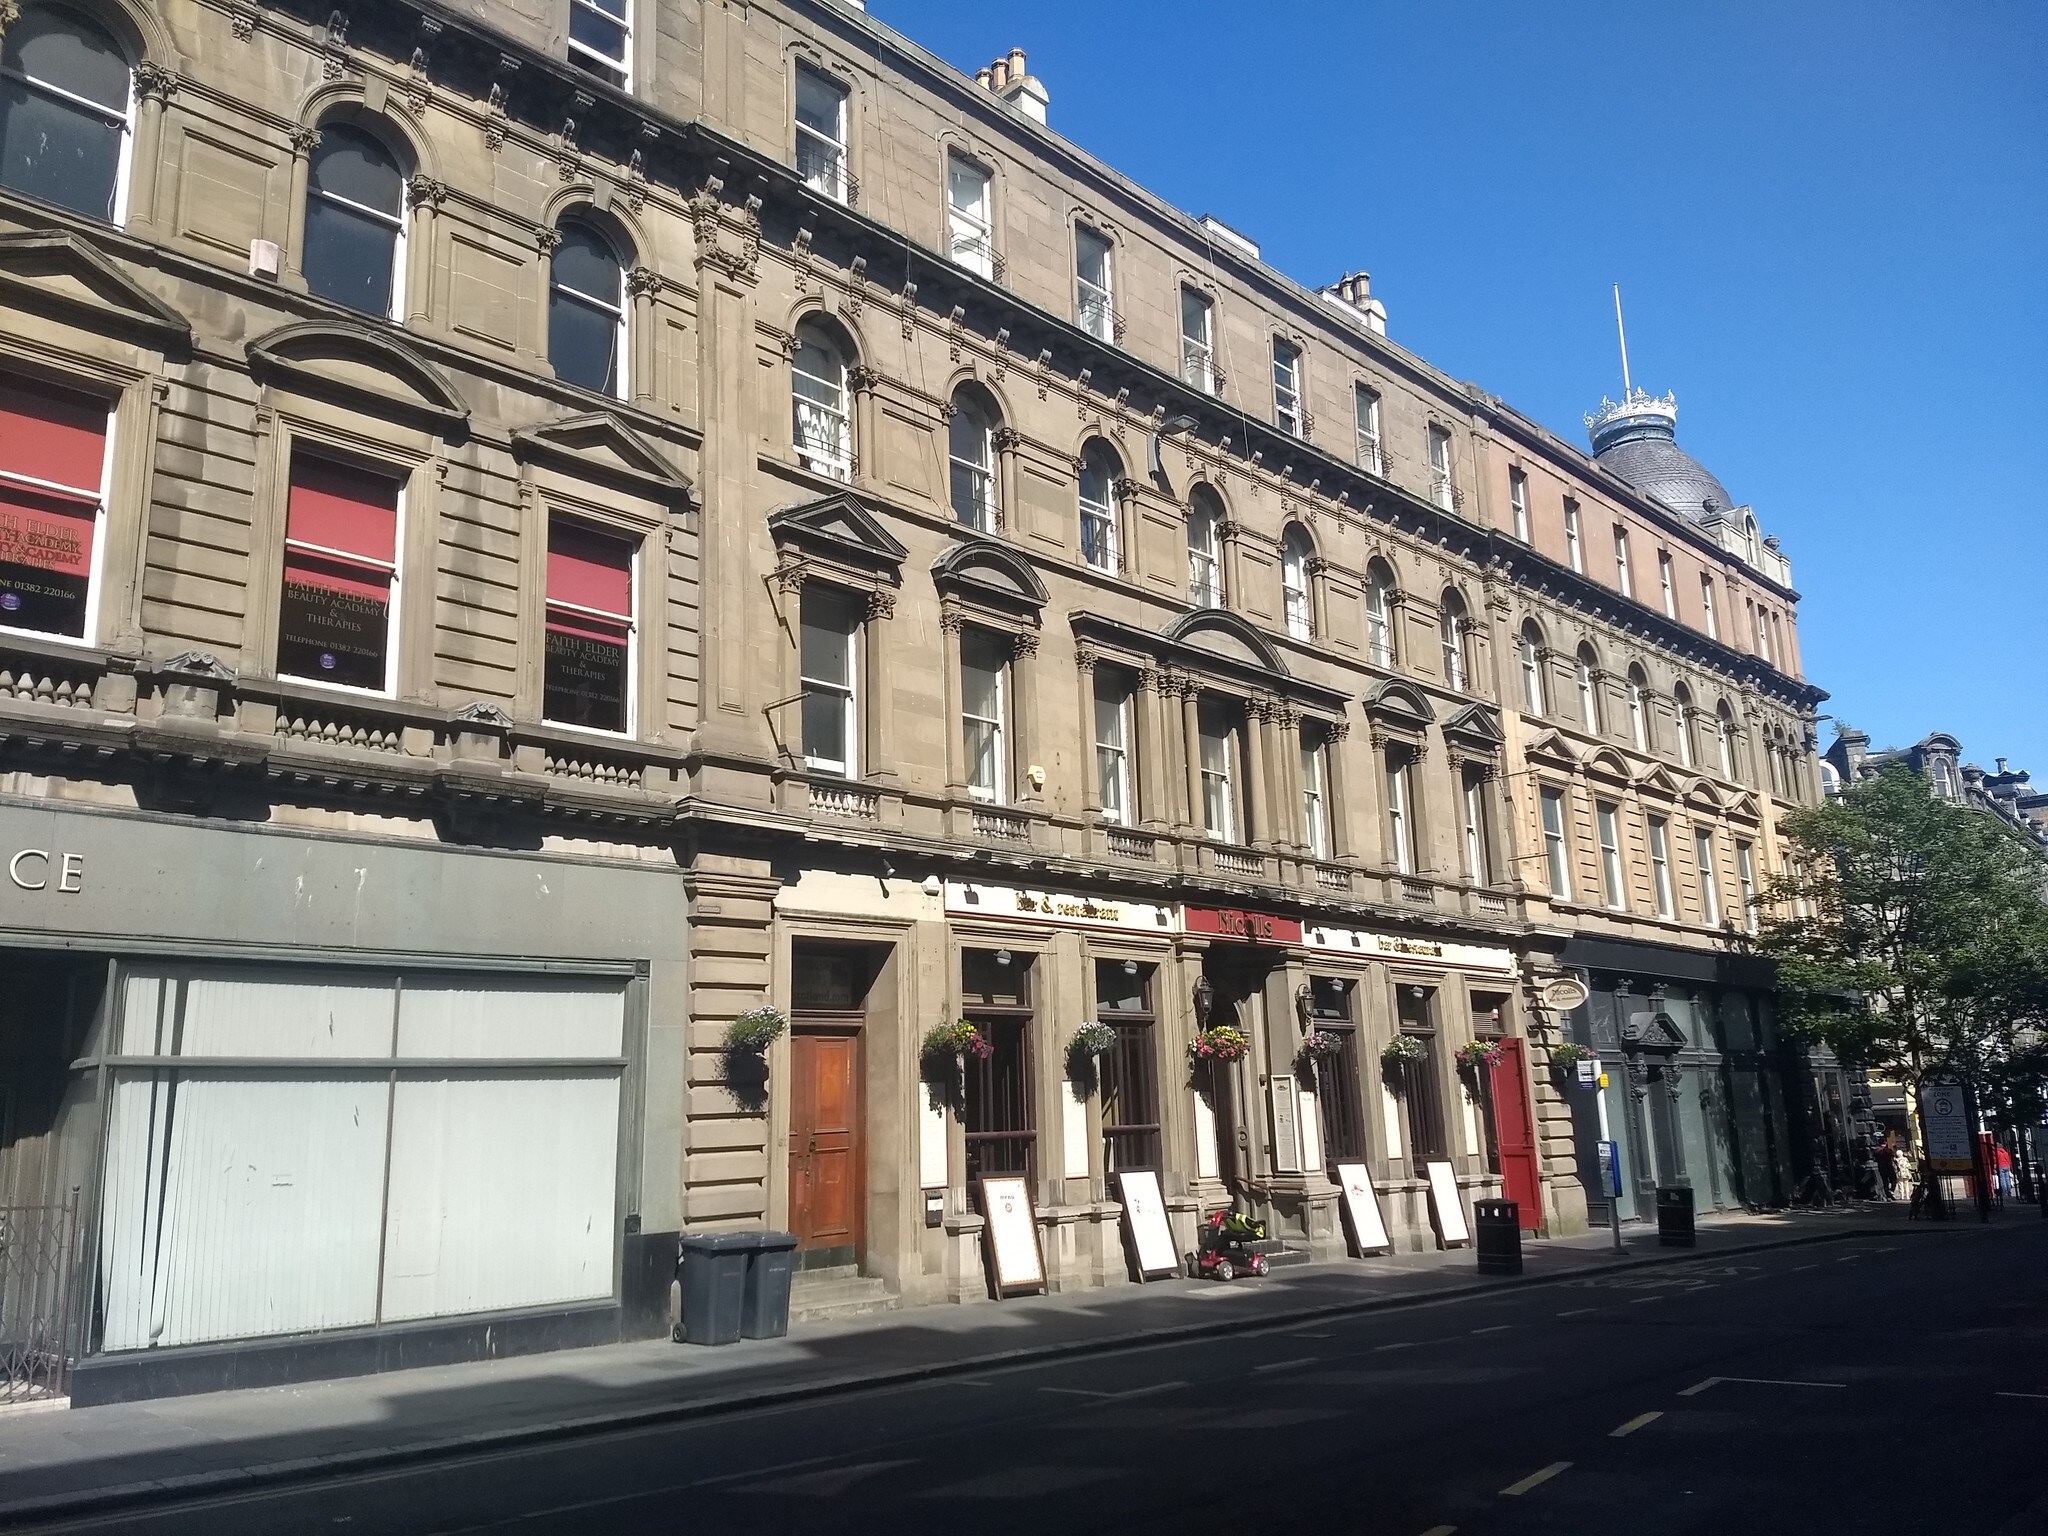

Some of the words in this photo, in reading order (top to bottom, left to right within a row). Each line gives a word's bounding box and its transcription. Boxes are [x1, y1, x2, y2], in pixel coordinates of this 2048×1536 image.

[27, 519, 79, 542] ELDER
[16, 543, 26, 554] &
[18, 532, 81, 553] ACADEMY
[14, 581, 41, 593] 01382
[43, 586, 76, 600] 220166
[287, 577, 331, 597] FAITH
[337, 587, 381, 608] ELDER
[287, 589, 328, 605] BEAUTY
[330, 599, 380, 616] ACADEMY
[307, 613, 361, 632] THERAPIES
[330, 608, 338, 618] &
[284, 633, 327, 648] TELEPHONE
[329, 642, 350, 652] 01382
[353, 646, 379, 658] 220166
[546, 633, 580, 650] FAITH
[585, 641, 619, 659] ELDER
[546, 643, 577, 658] BEAUTY
[580, 652, 620, 667] ACADEMY
[561, 664, 606, 681] THERAPIES
[579, 660, 586, 669] &
[1041, 895, 1054, 914] &
